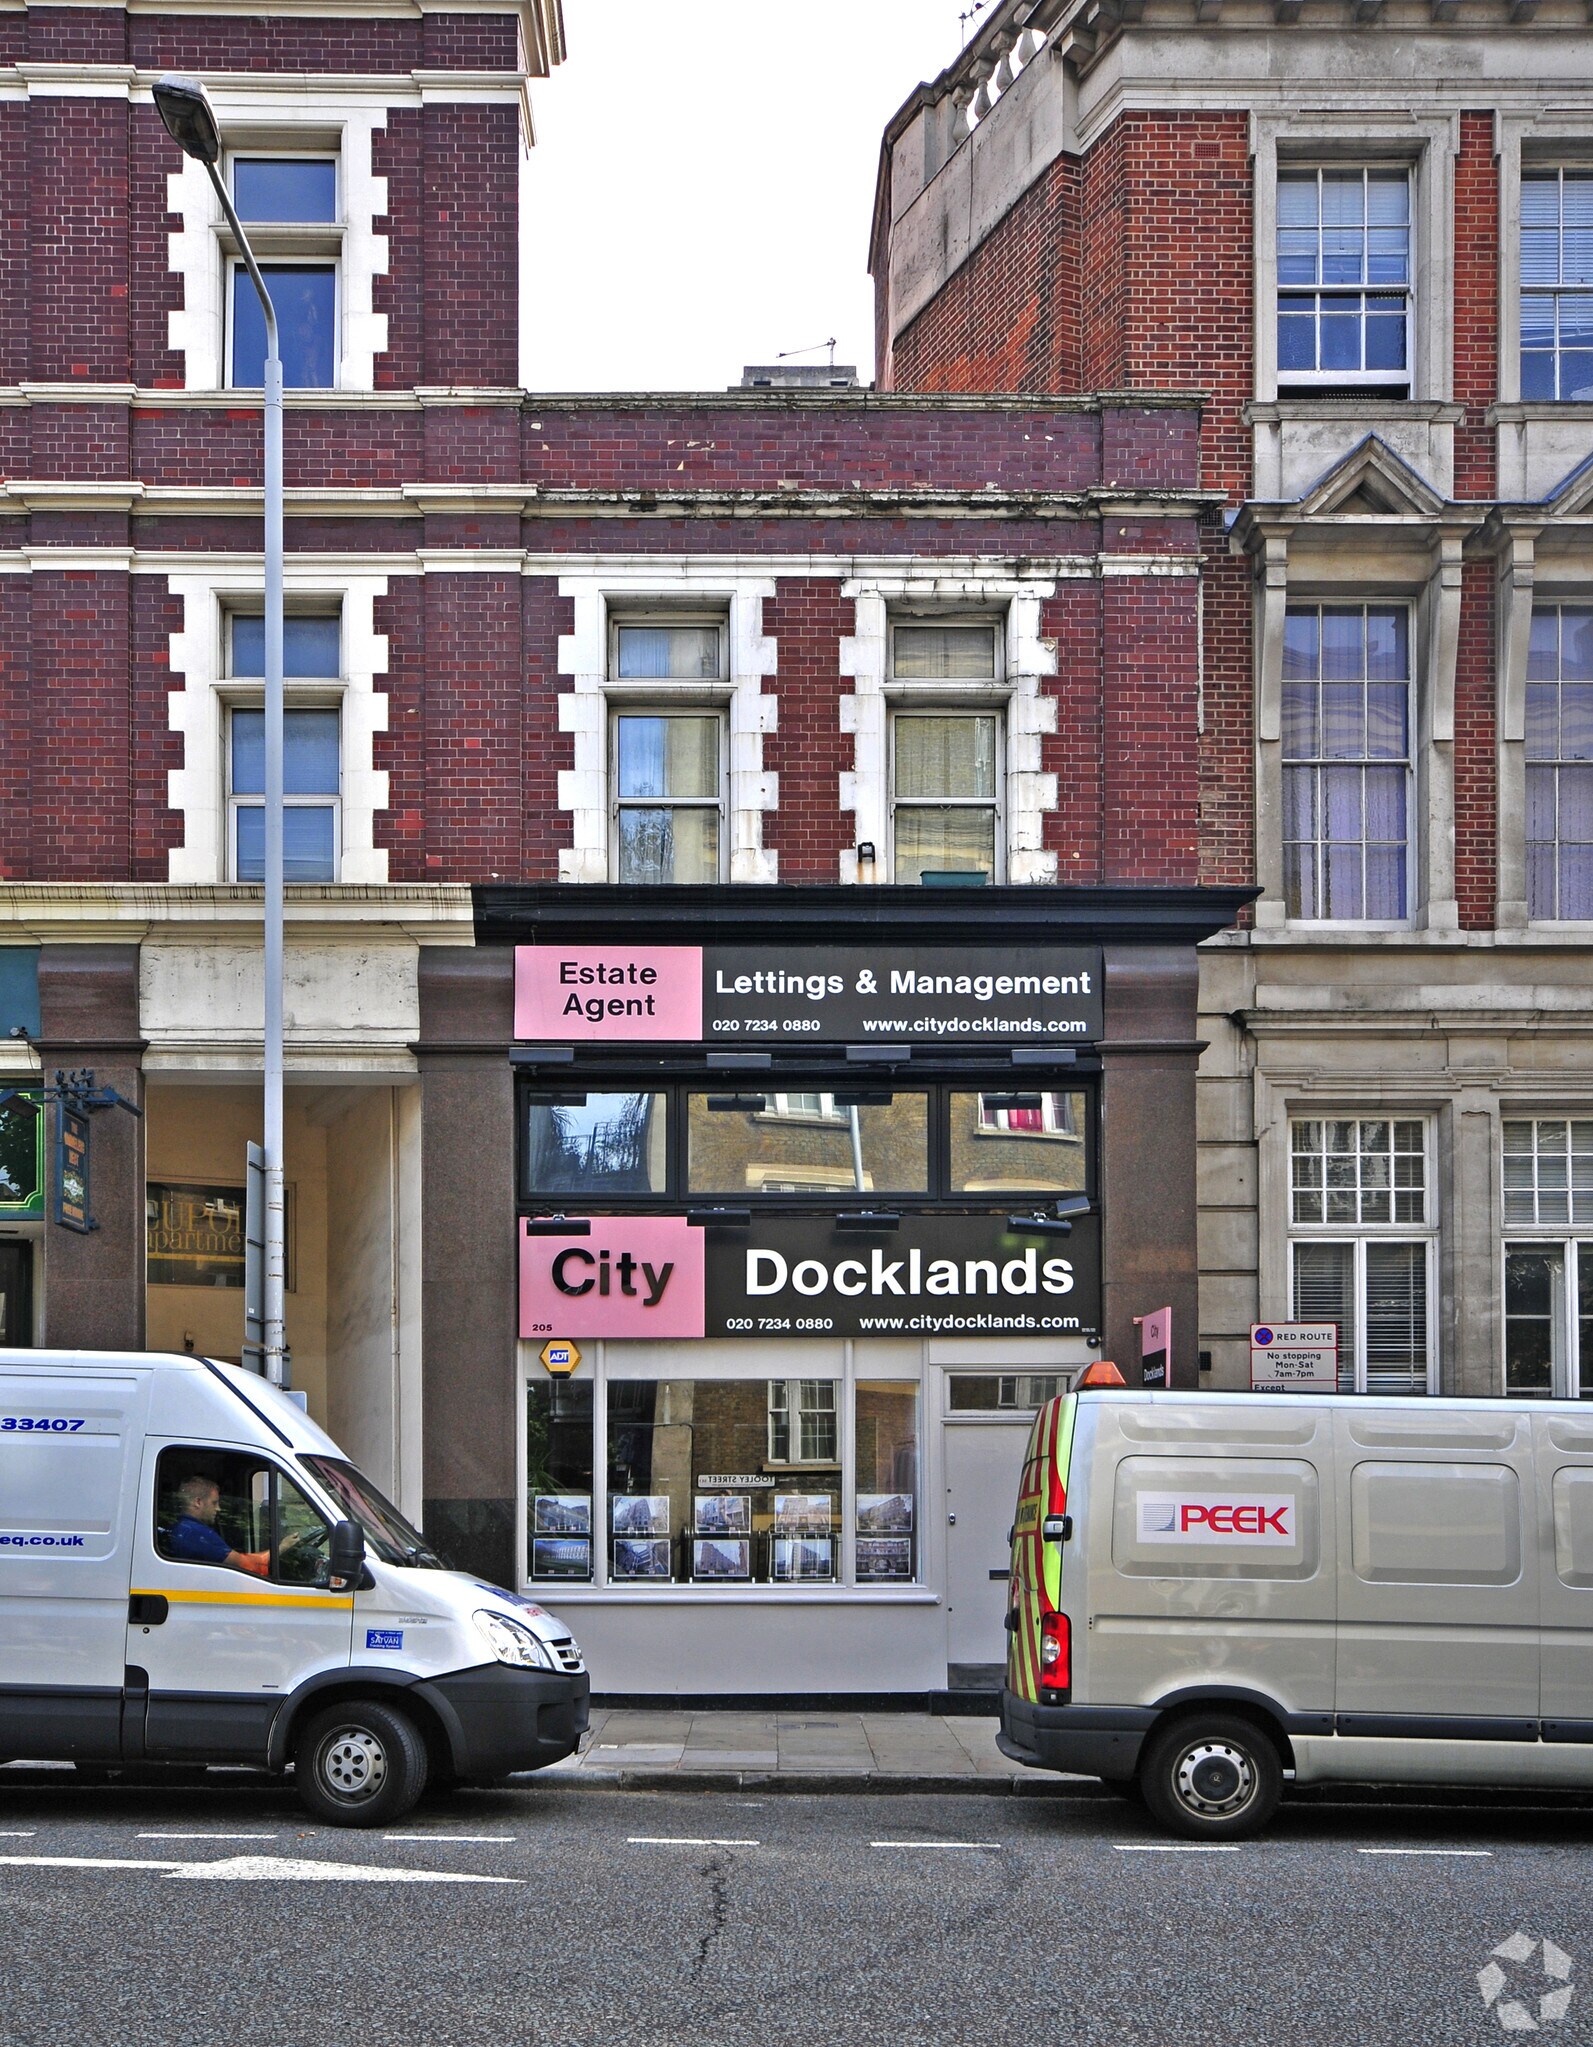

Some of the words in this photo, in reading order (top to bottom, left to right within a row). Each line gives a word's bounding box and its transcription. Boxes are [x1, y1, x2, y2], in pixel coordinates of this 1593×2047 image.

[559, 961, 658, 985] Estate
[716, 970, 844, 1000] Lettings
[855, 969, 878, 994] &
[890, 970, 1091, 1001] Management
[562, 993, 656, 1023] Agent
[712, 1020, 740, 1031] 020
[744, 1020, 778, 1031] 7234
[782, 1020, 821, 1031] 0880
[862, 1017, 1087, 1035] www.citydocklands.com
[551, 1247, 675, 1306] City
[746, 1247, 1075, 1296] Docklands
[532, 1323, 553, 1332] 205
[726, 1318, 754, 1330] 020
[757, 1318, 791, 1330] 7234
[795, 1318, 833, 1330] 0880
[859, 1314, 1080, 1331] www.citydocklands.com
[1276, 1333, 1297, 1341] RED
[550, 1352, 569, 1362] ADT
[1267, 1352, 1280, 1360] No
[1282, 1352, 1321, 1360] stopping
[1274, 1370, 1314, 1378] 7am-7pm
[1, 1418, 85, 1431] 33407
[1181, 1505, 1289, 1535] PEEK
[0, 1536, 84, 1547] eq.co.uk
